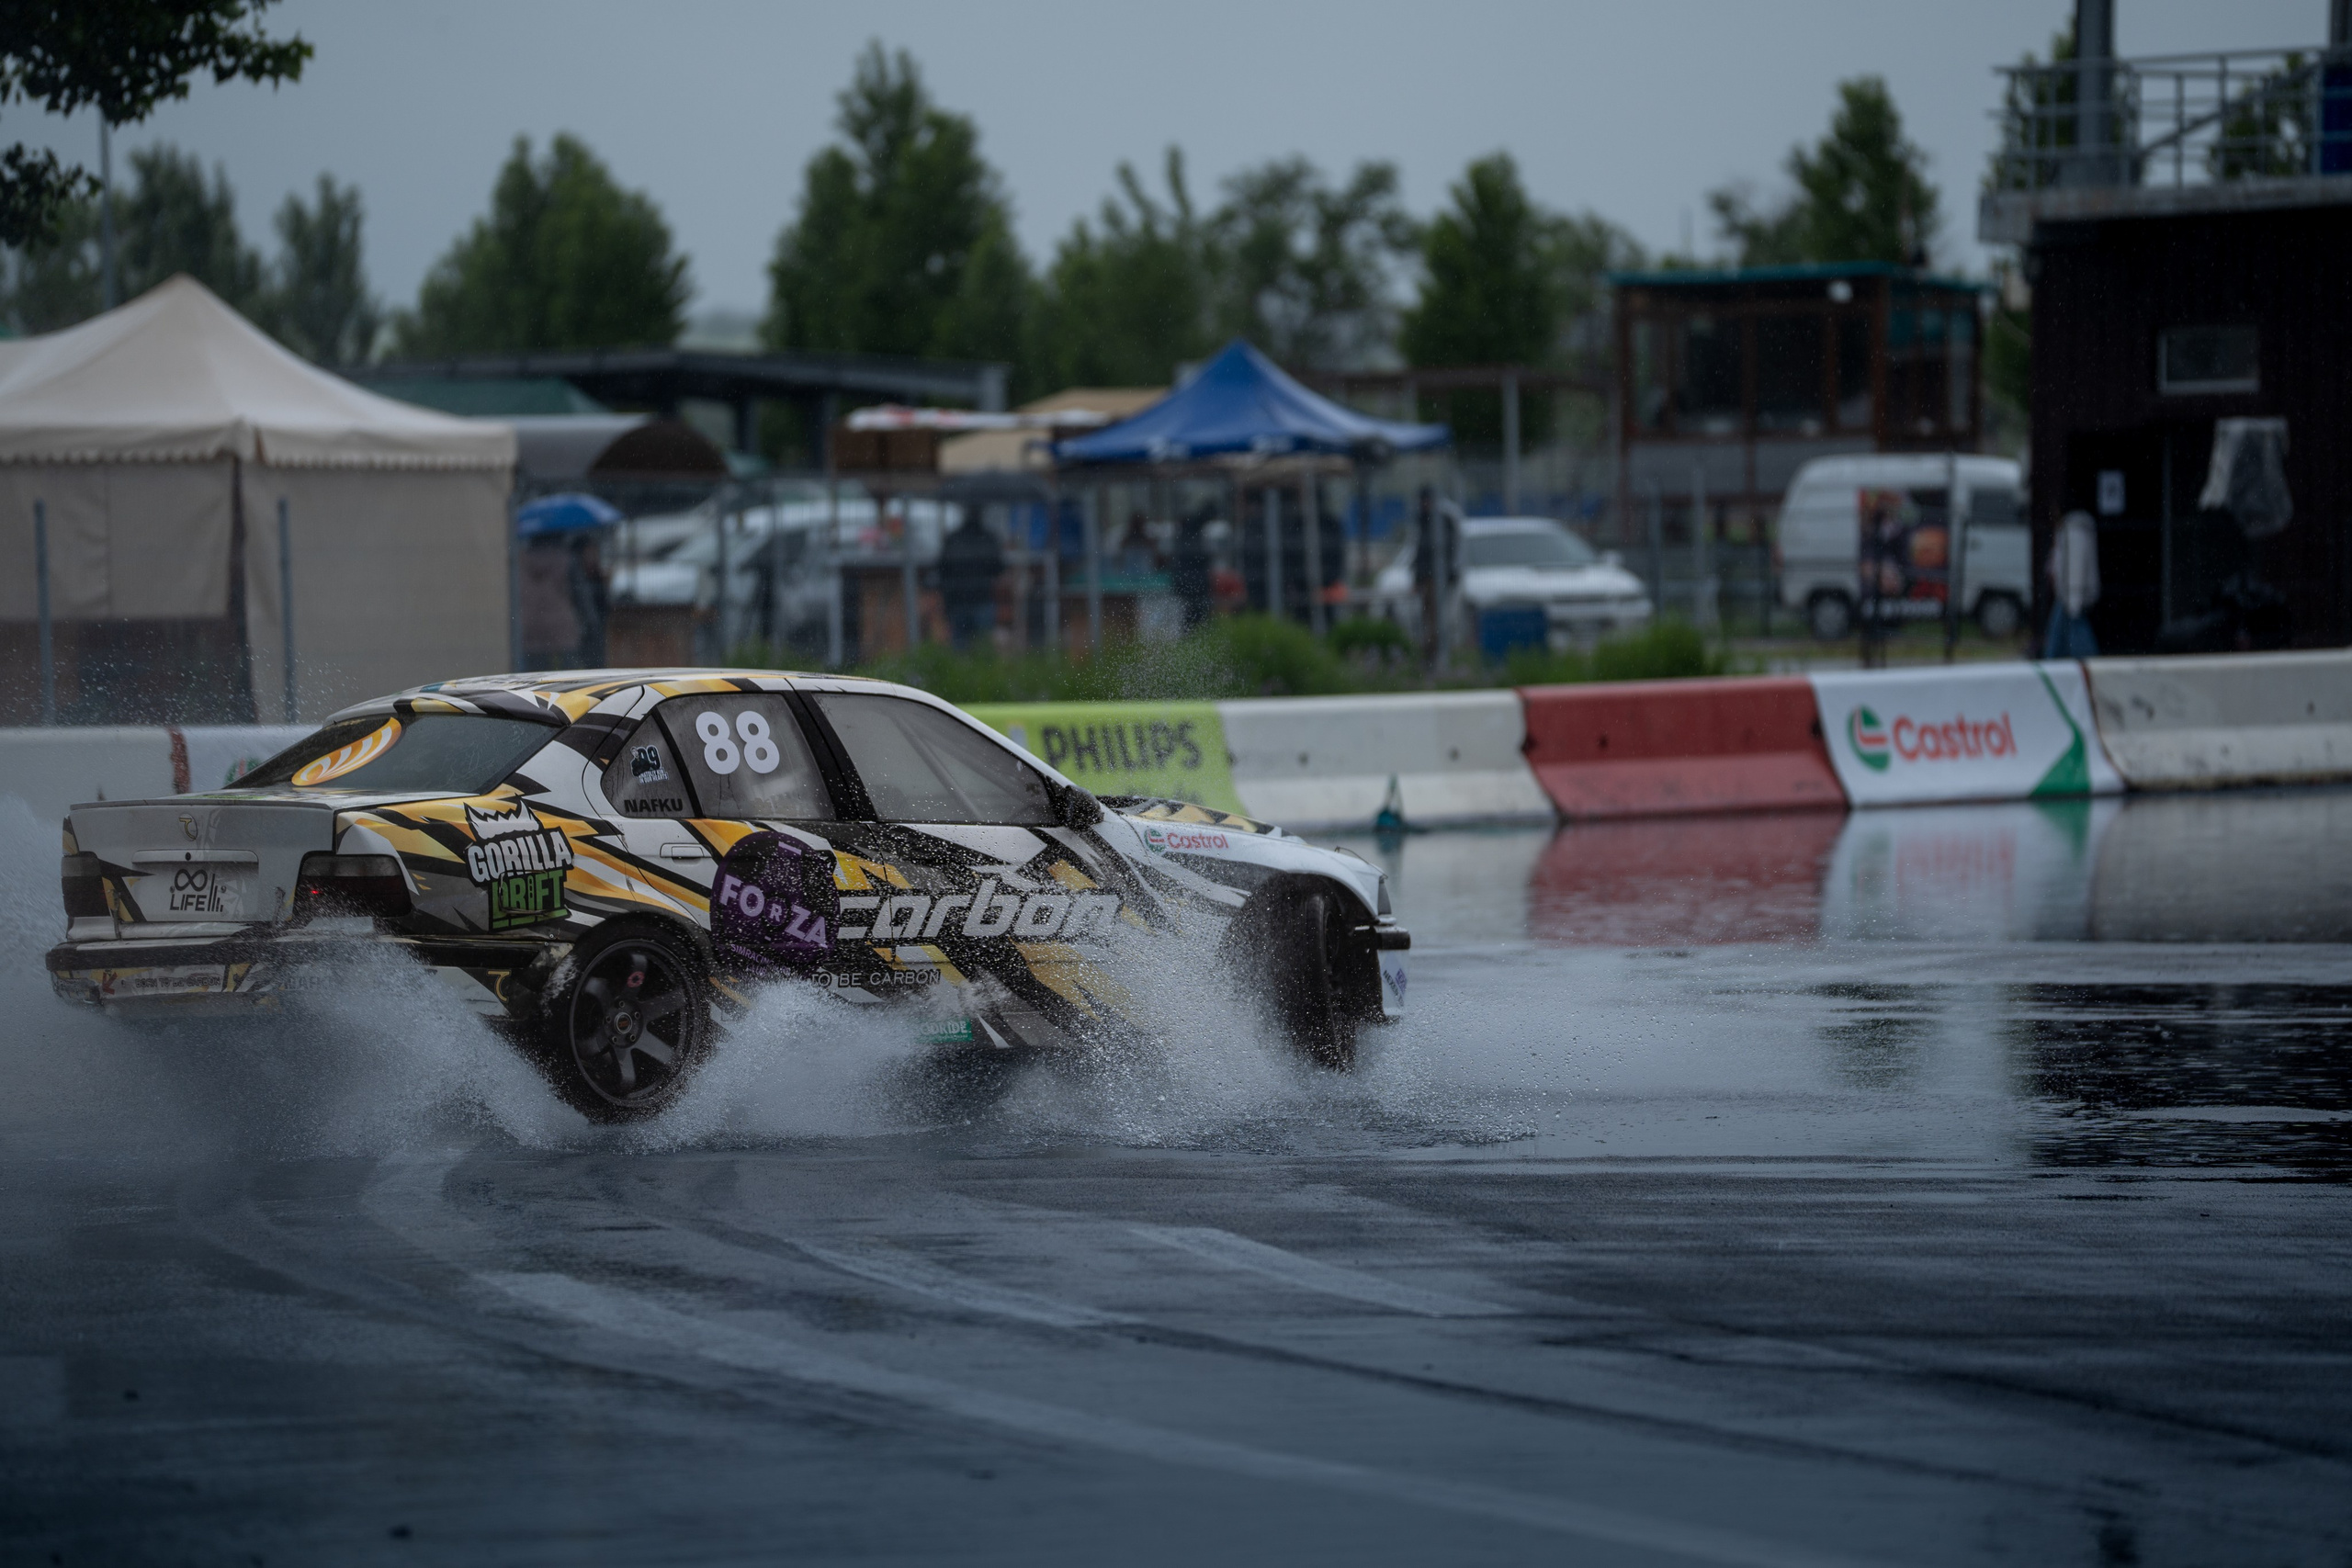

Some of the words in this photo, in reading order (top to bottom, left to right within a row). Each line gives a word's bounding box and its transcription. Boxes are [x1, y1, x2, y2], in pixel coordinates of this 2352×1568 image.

[695, 710, 780, 775] 88
[1042, 722, 1203, 772] PHILIPS
[1893, 712, 2018, 762] Castrol
[624, 799, 683, 812] NAFKU
[468, 830, 571, 882] GORILLA
[1167, 832, 1228, 849] Castrol
[169, 893, 208, 911] LIFE
[492, 869, 563, 921] DRIFT
[719, 874, 828, 948] FORZA
[811, 974, 831, 987] TO
[839, 973, 862, 986] BE
[869, 970, 940, 986] CARBON
